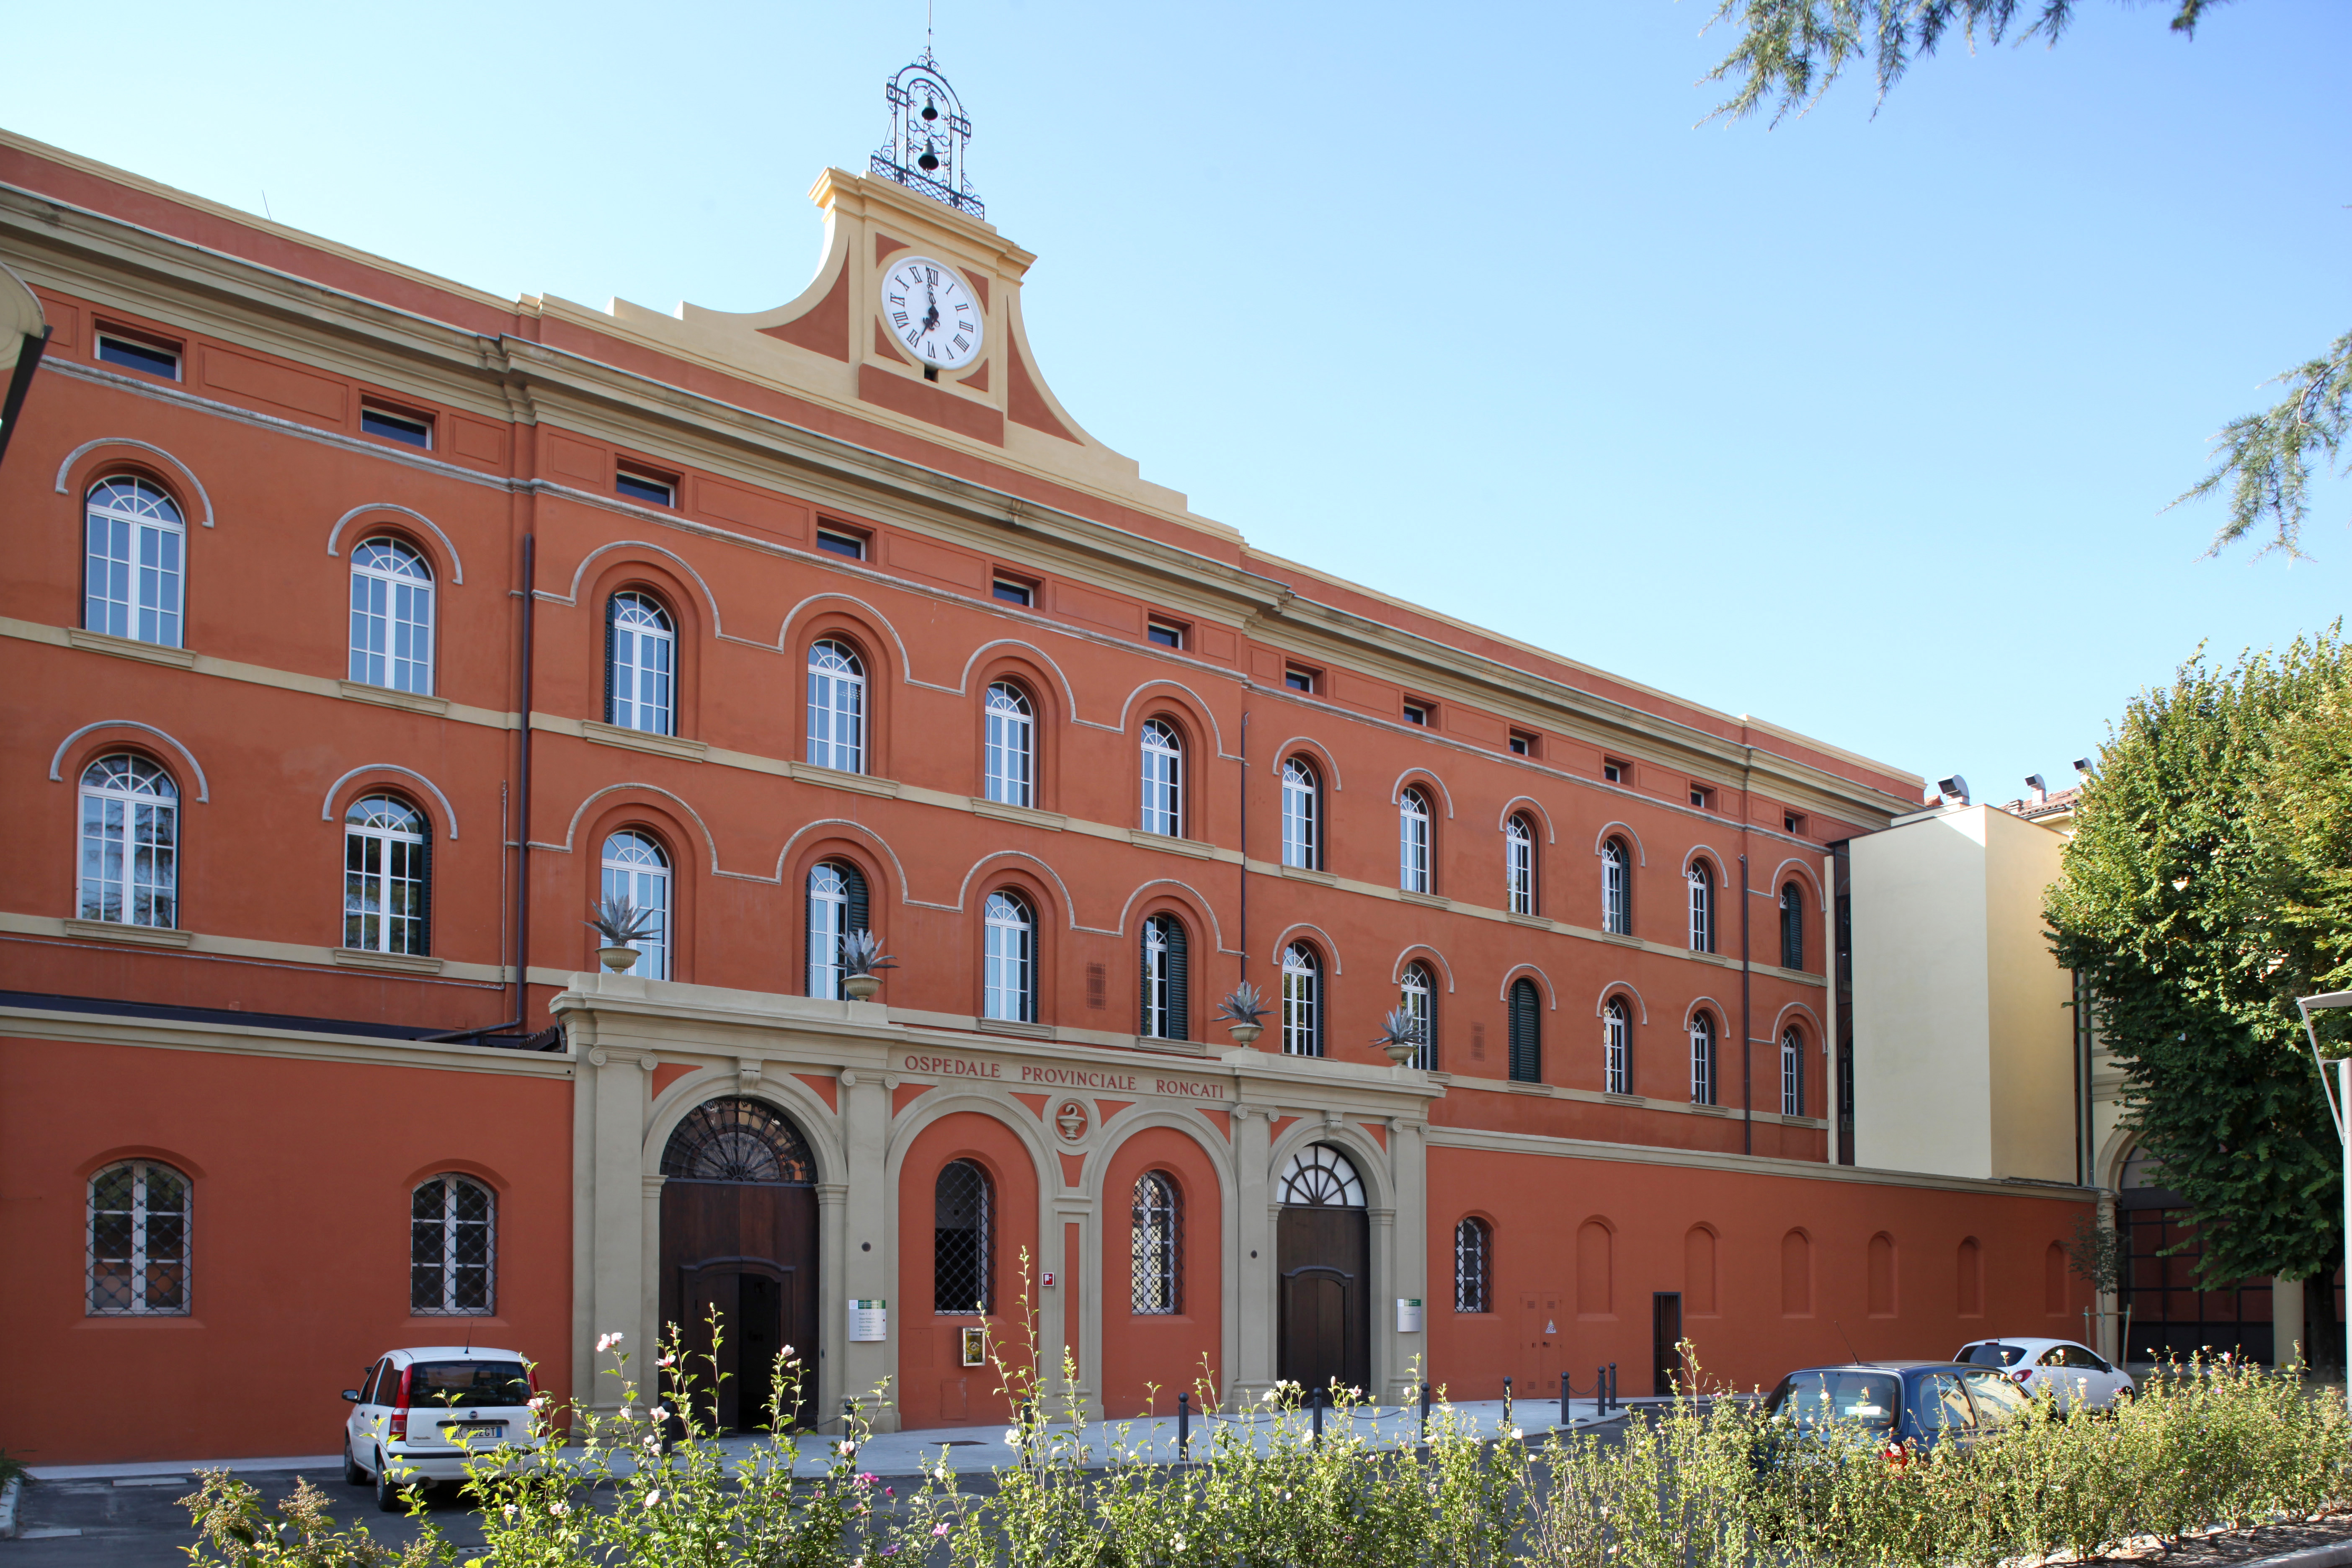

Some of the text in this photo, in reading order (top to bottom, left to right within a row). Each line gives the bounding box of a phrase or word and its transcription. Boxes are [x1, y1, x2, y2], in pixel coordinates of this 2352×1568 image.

[905, 1055, 1223, 1099] OSPEDALE PROVINCIALE RONCATI
